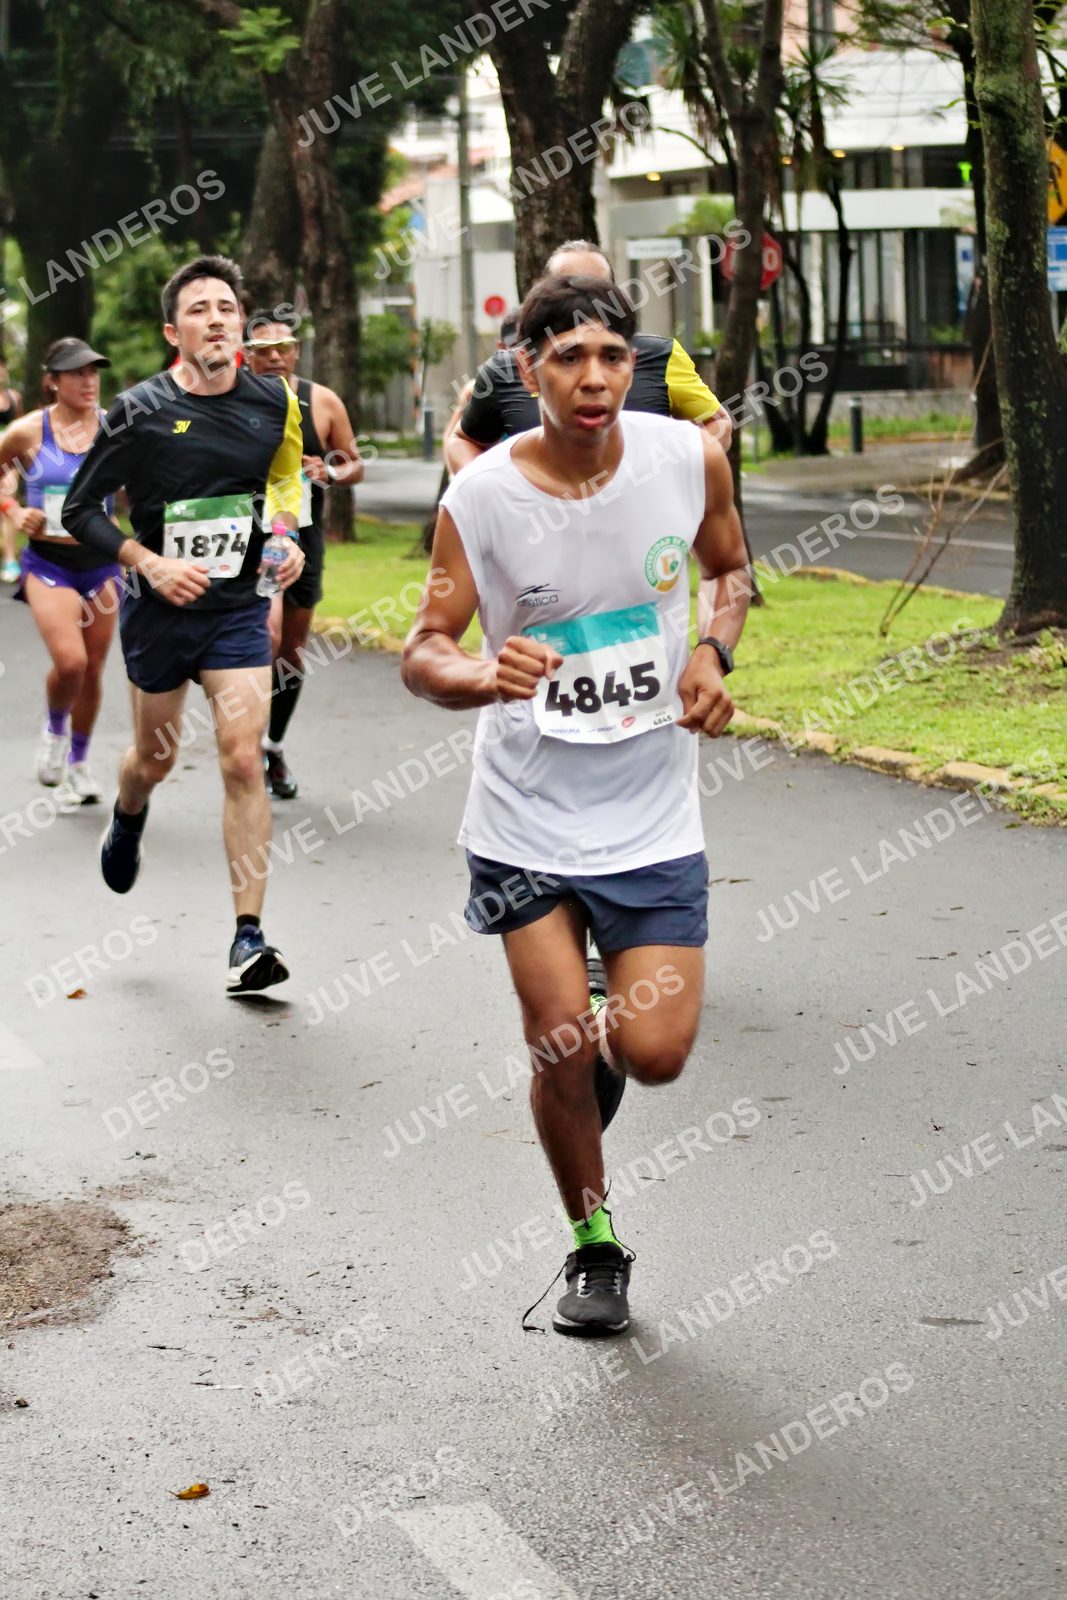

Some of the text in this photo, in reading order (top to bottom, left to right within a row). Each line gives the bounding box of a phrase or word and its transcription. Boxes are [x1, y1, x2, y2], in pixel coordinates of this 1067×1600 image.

[173, 532, 247, 559] 1874
[545, 661, 661, 717] 4845
[653, 715, 673, 726] 4845
